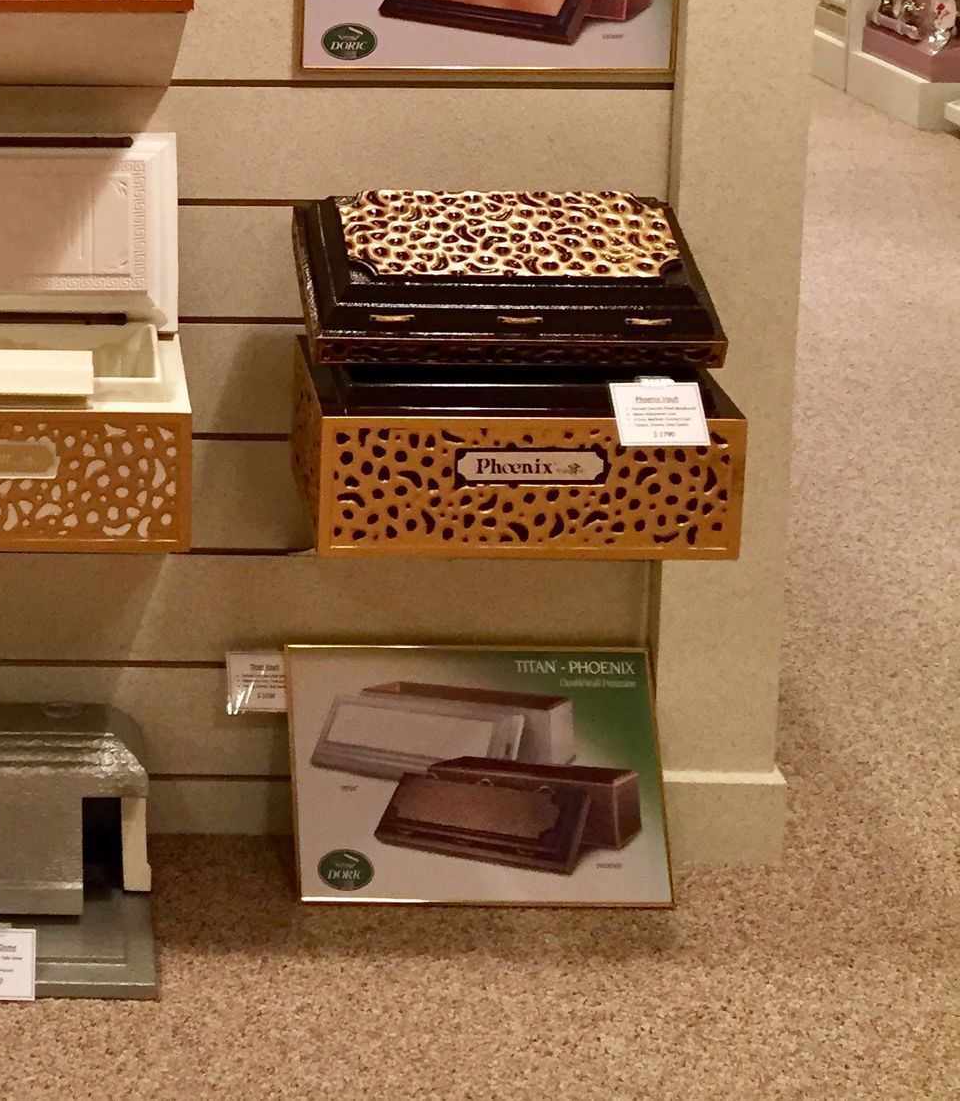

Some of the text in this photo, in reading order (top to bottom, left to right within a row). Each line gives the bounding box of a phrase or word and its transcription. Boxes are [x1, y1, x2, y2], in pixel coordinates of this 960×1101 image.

[330, 41, 368, 50] DORIC
[513, 659, 556, 674] TITAN
[568, 660, 636, 675] PHOENIX
